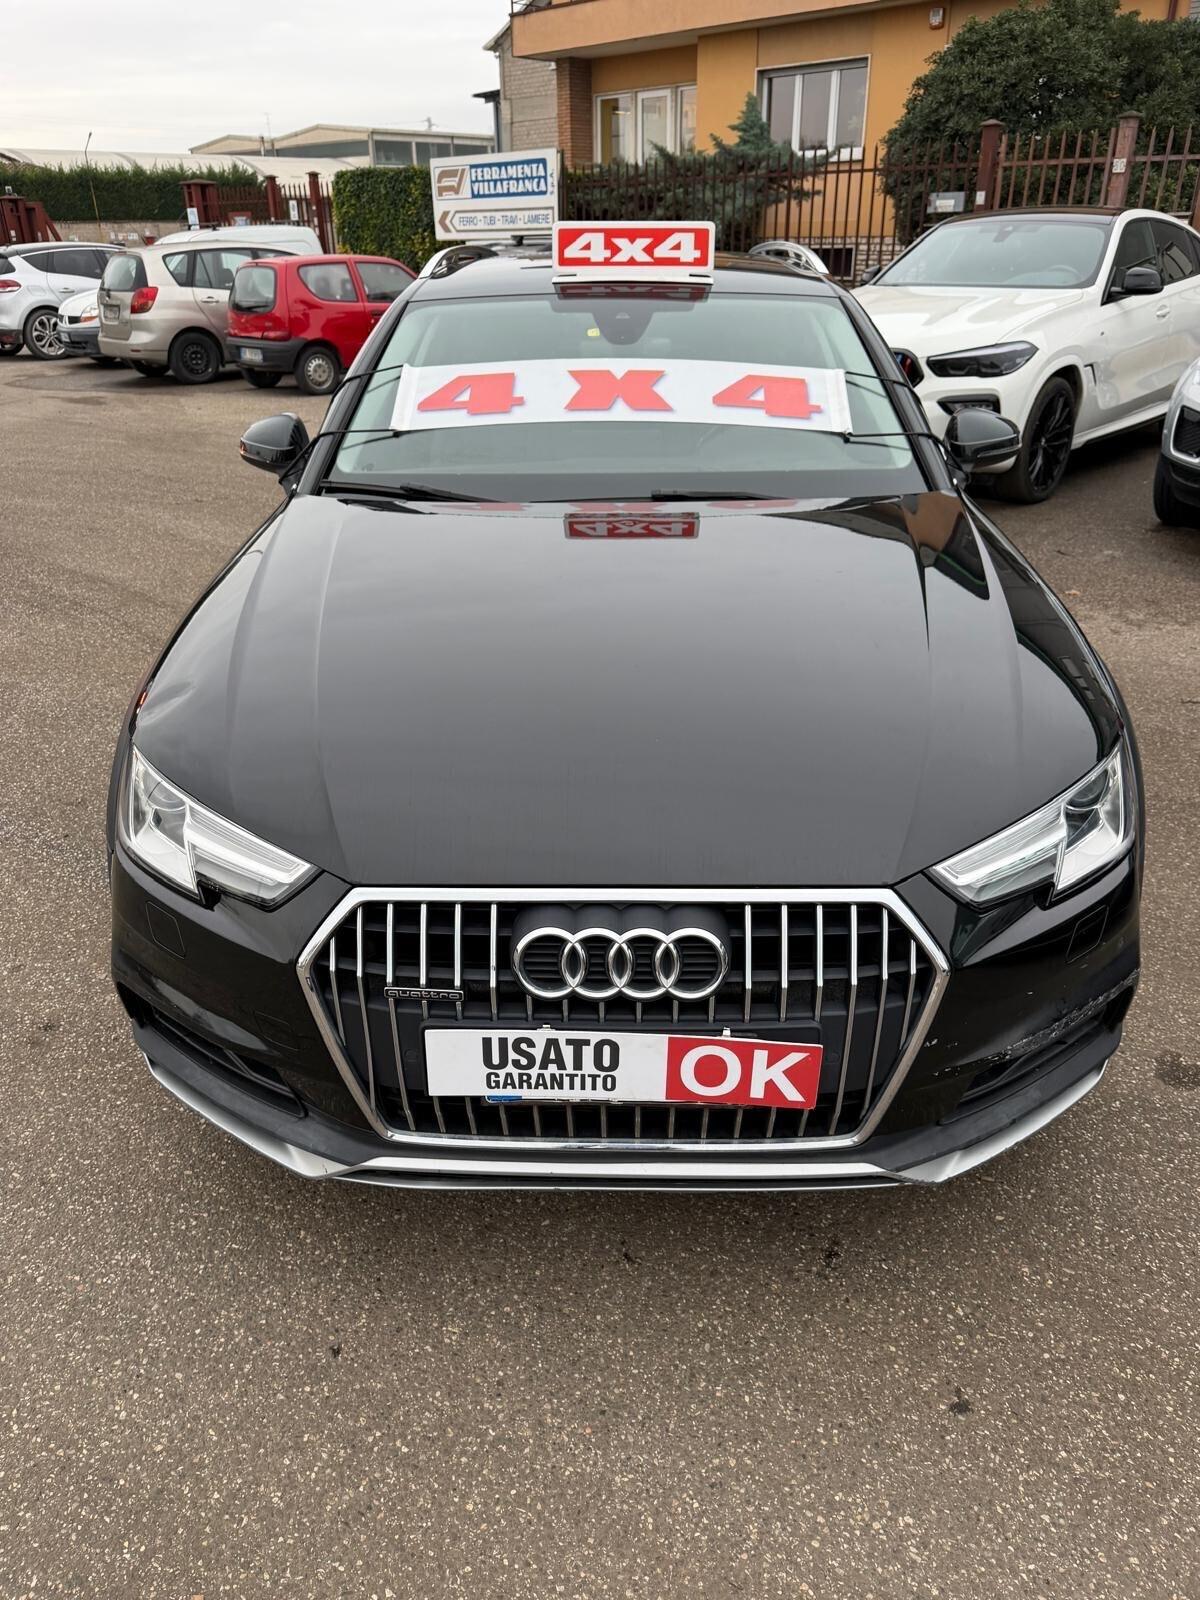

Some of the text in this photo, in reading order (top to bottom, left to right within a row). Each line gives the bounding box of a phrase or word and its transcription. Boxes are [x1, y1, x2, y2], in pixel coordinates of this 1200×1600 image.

[471, 163, 545, 181] FERRAMENTA
[471, 178, 547, 195] VILLAFRANCA
[458, 213, 550, 227] FERRO TUBI TRAVI LAMIERE
[563, 232, 701, 263] 4x4
[417, 373, 524, 415] 4
[712, 375, 822, 419] 4
[387, 990, 460, 999] quattro
[481, 1037, 811, 1102] USATO OK
[485, 1072, 617, 1092] GARANTITO
